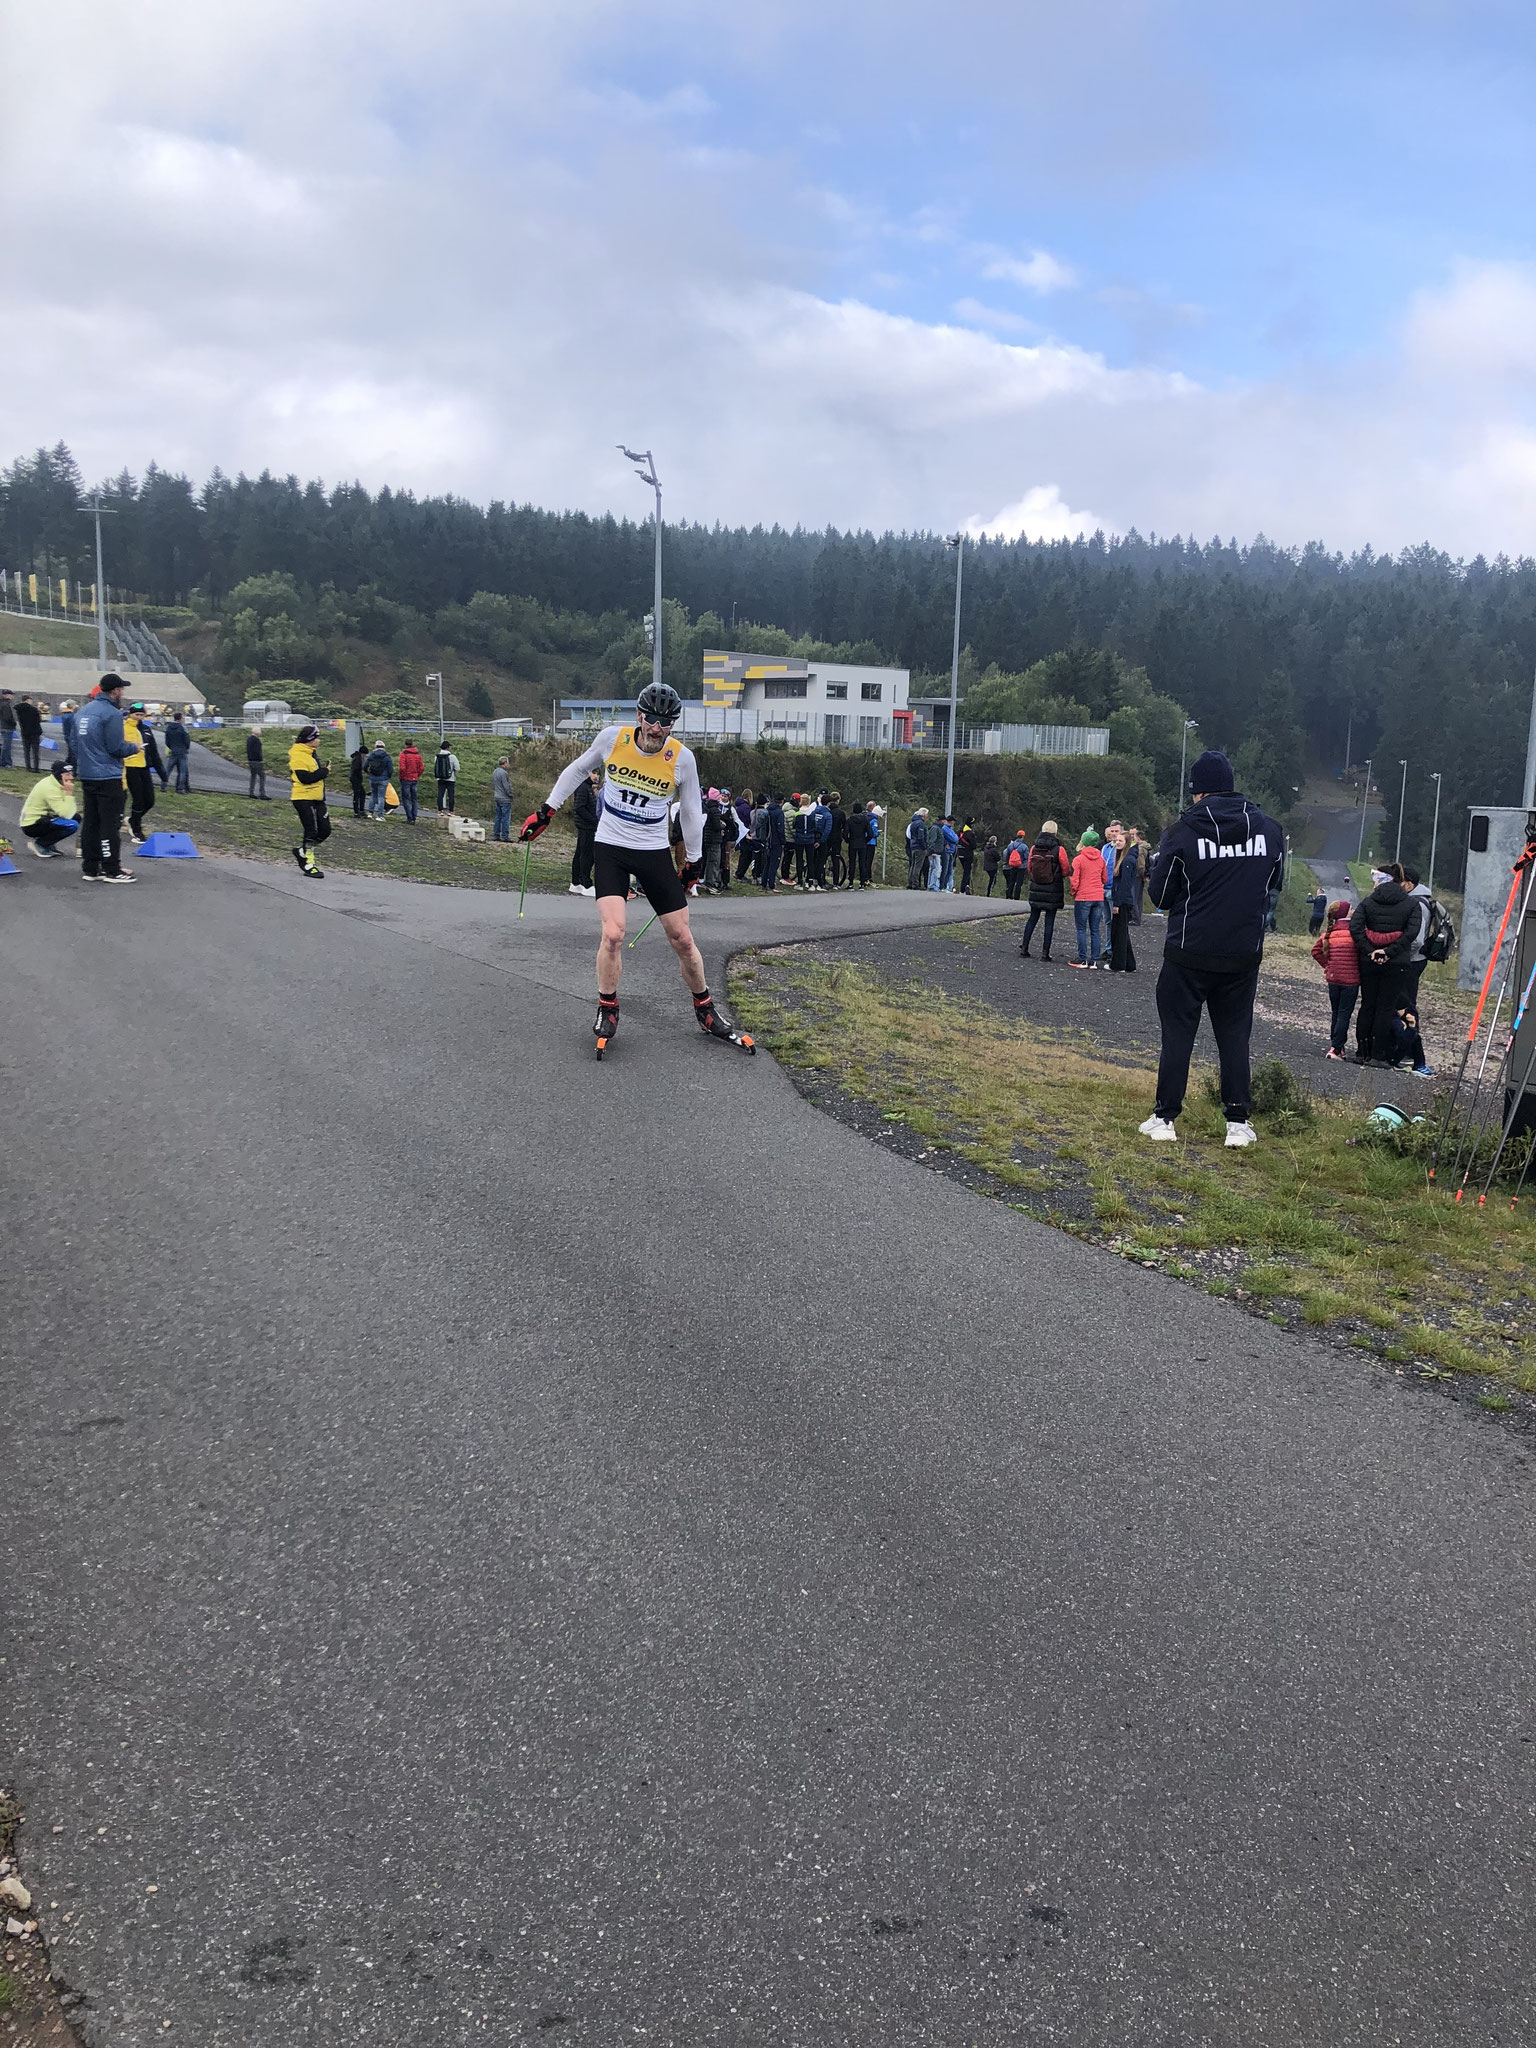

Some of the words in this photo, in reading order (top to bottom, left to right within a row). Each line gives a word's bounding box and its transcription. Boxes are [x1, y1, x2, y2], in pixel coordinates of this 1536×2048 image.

[618, 766, 670, 789] Oßwald
[619, 789, 650, 808] 177
[1197, 834, 1267, 860] ITALIA
